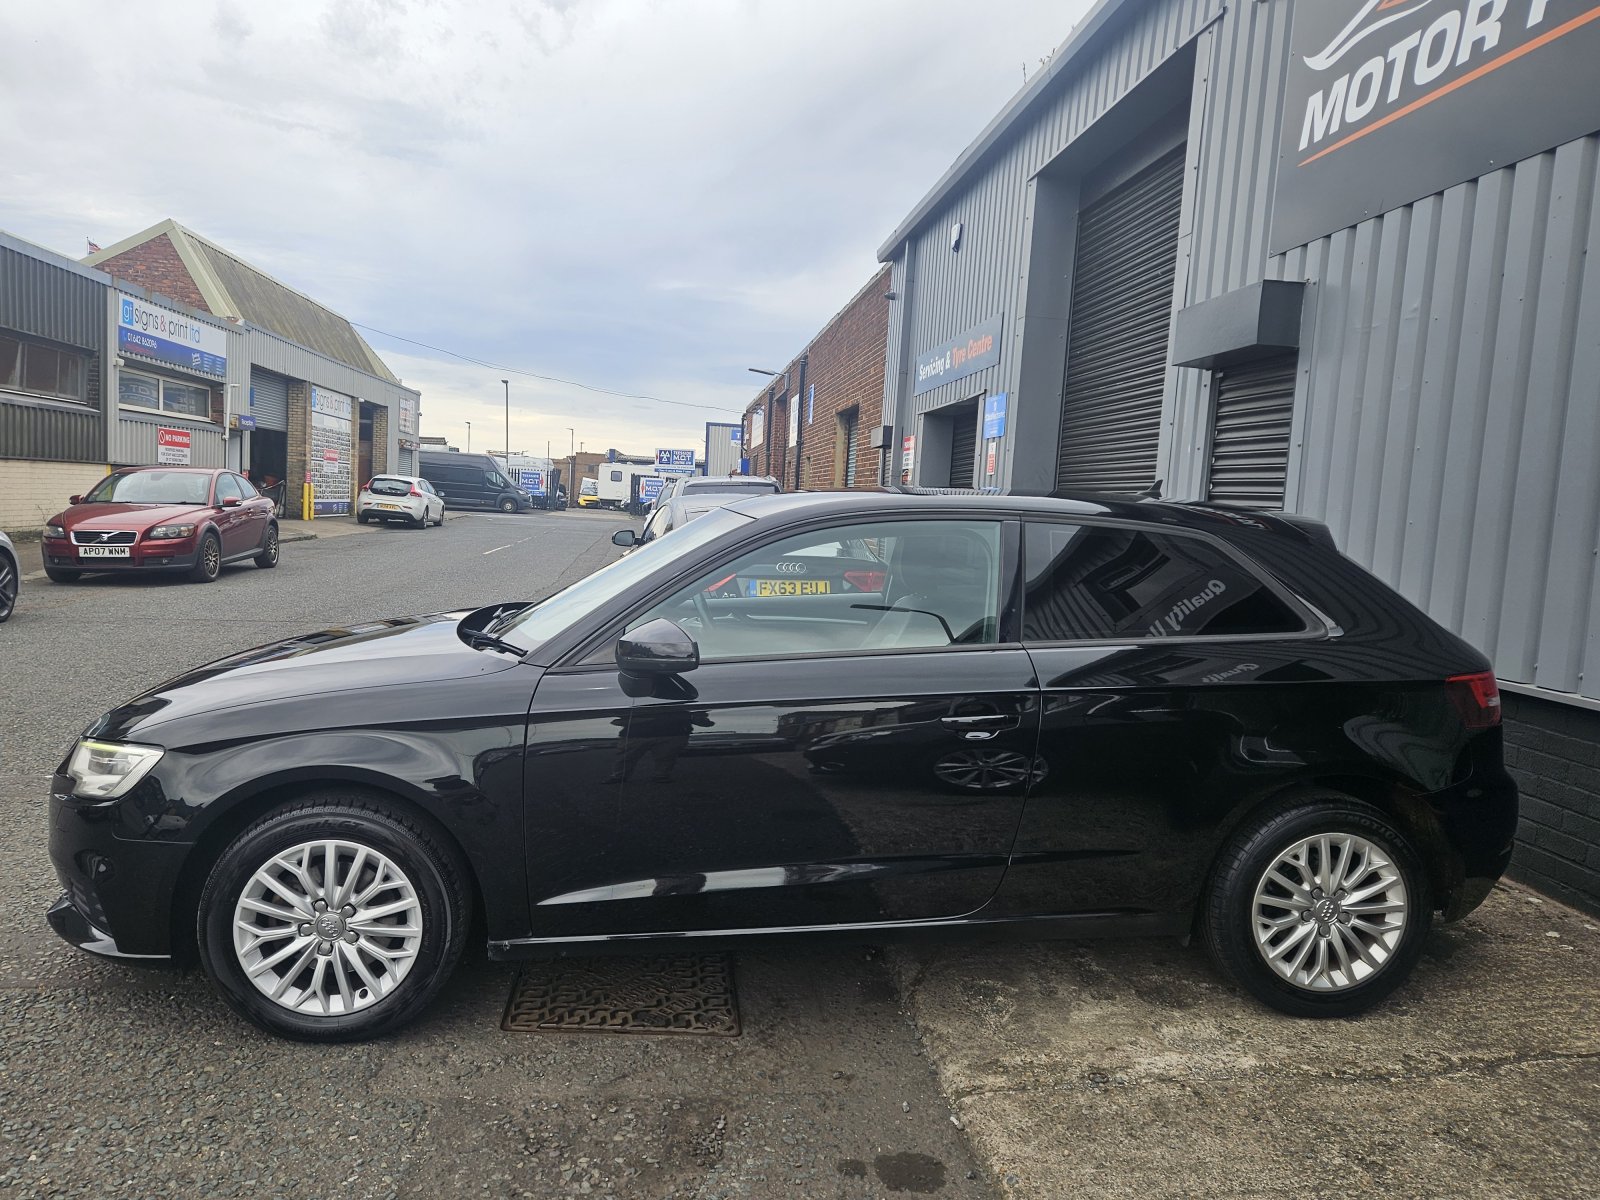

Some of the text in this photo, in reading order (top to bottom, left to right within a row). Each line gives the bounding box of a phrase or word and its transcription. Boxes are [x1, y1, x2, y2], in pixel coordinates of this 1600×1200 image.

[1299, 0, 1504, 152] MOTOR
[135, 304, 158, 331] signs
[160, 314, 166, 332] &
[169, 319, 188, 339] print
[190, 323, 200, 343] ltd
[919, 334, 993, 381] Servicing & Tyre Centre
[165, 432, 190, 444] NO PARKING
[83, 547, 126, 556] AP07 WNM
[759, 581, 797, 595] FX63
